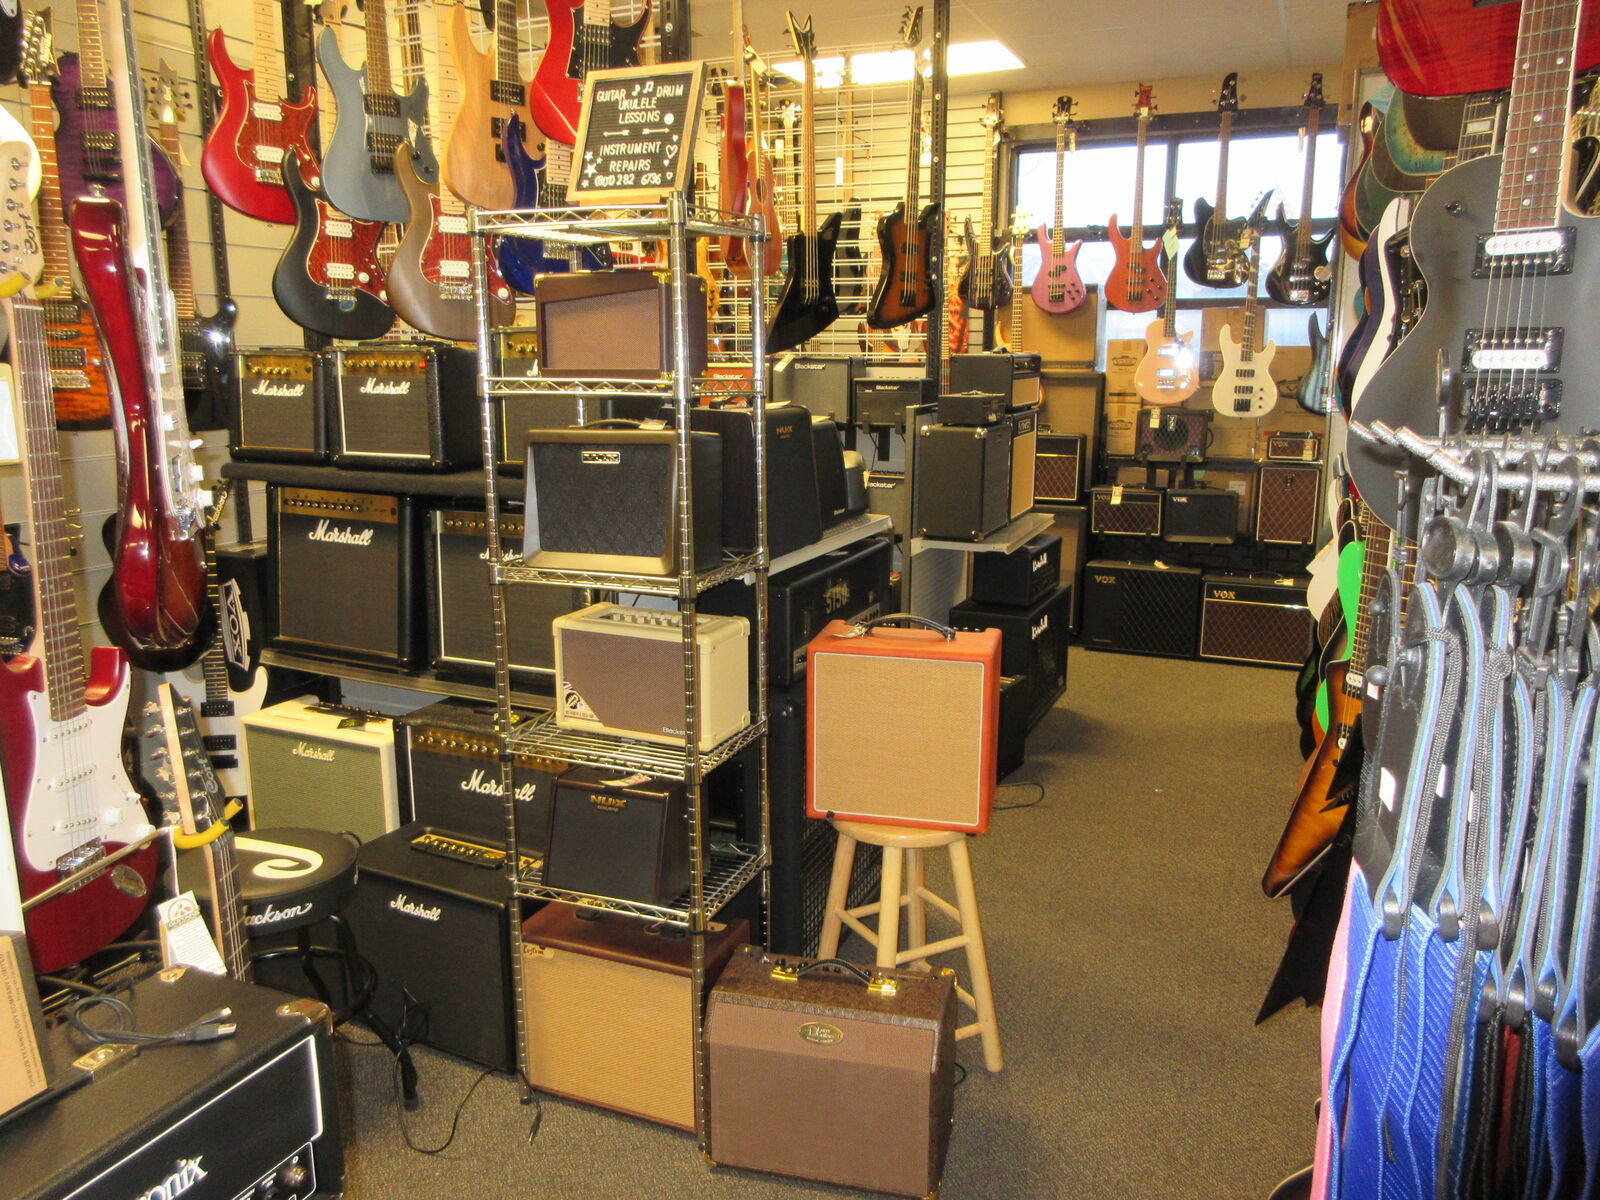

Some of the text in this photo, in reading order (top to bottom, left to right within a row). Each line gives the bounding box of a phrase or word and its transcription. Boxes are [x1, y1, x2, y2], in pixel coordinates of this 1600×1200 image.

[596, 84, 684, 102] GUITAR DRUM
[618, 97, 658, 111] UKULELE
[618, 110, 661, 124] LESSONS
[600, 141, 662, 157] INSTRUMENT
[609, 159, 651, 172] REPAIRS
[616, 173, 635, 186] 282
[640, 172, 661, 186] 6736
[252, 379, 305, 397] Marshall
[360, 377, 411, 395] Marshall
[308, 519, 374, 546] Marshall
[1095, 575, 1117, 584] VOX
[1213, 589, 1236, 599] VOX
[292, 741, 335, 762] Marshall
[390, 893, 441, 921] Marshall
